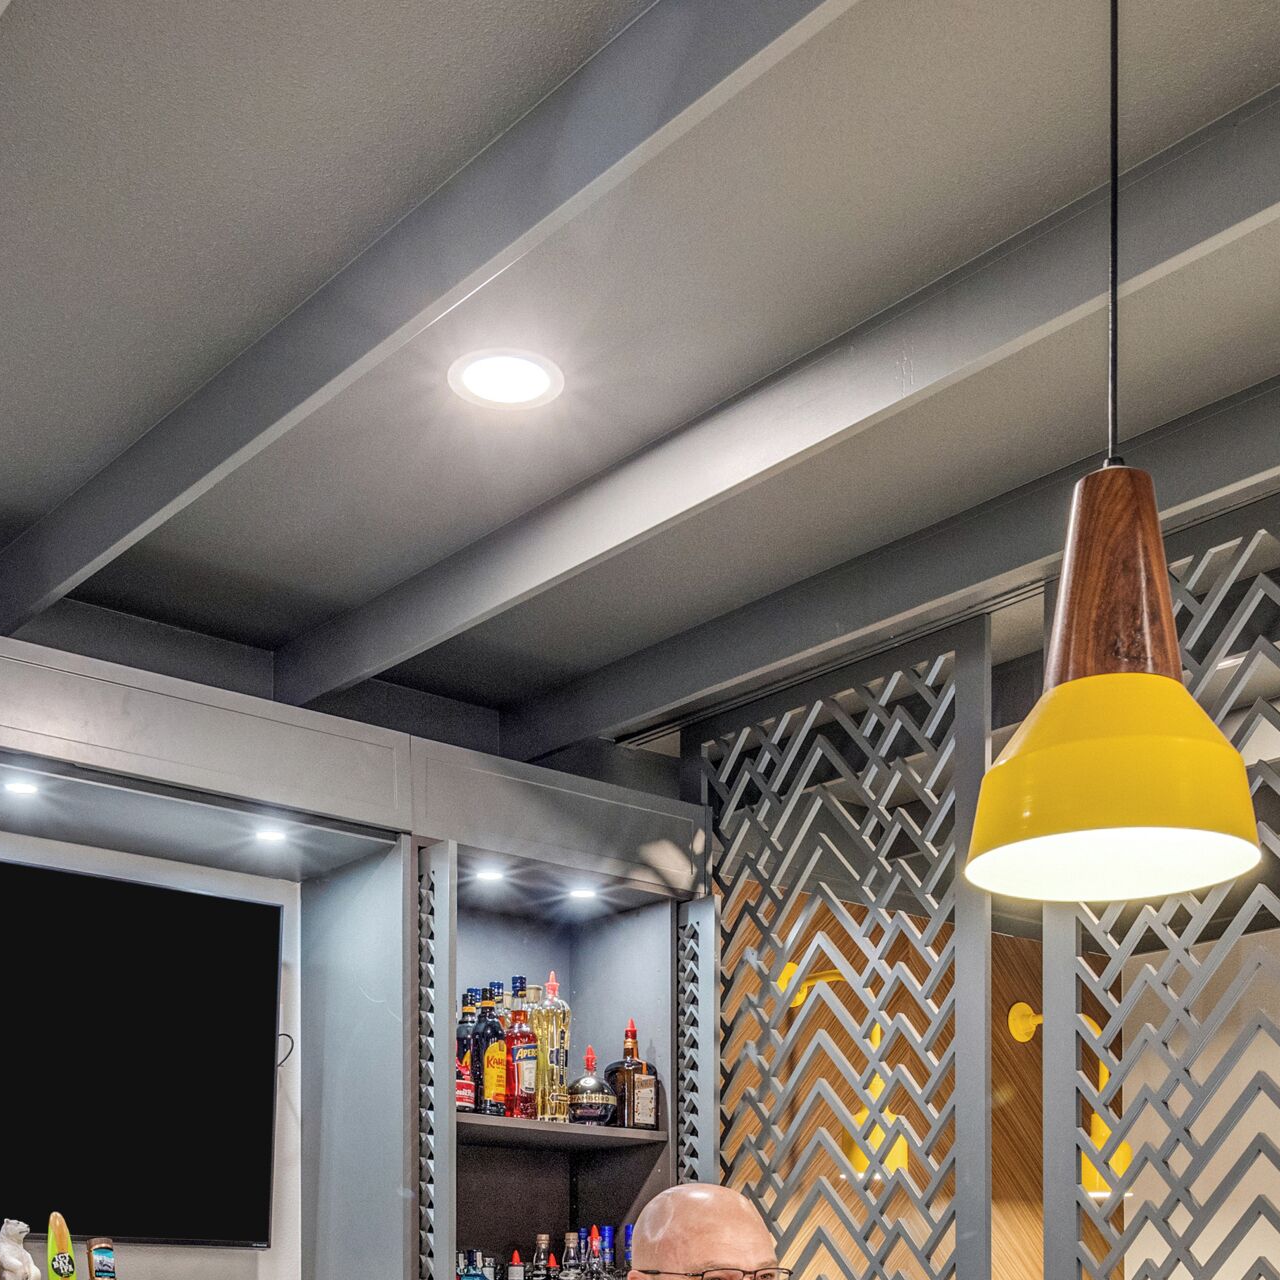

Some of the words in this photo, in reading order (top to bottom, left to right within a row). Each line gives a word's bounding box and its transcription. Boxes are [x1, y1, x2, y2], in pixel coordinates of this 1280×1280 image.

[54, 1252, 70, 1262] ICY
[52, 1259, 70, 1270] BAY
[59, 1265, 74, 1275] IPA
